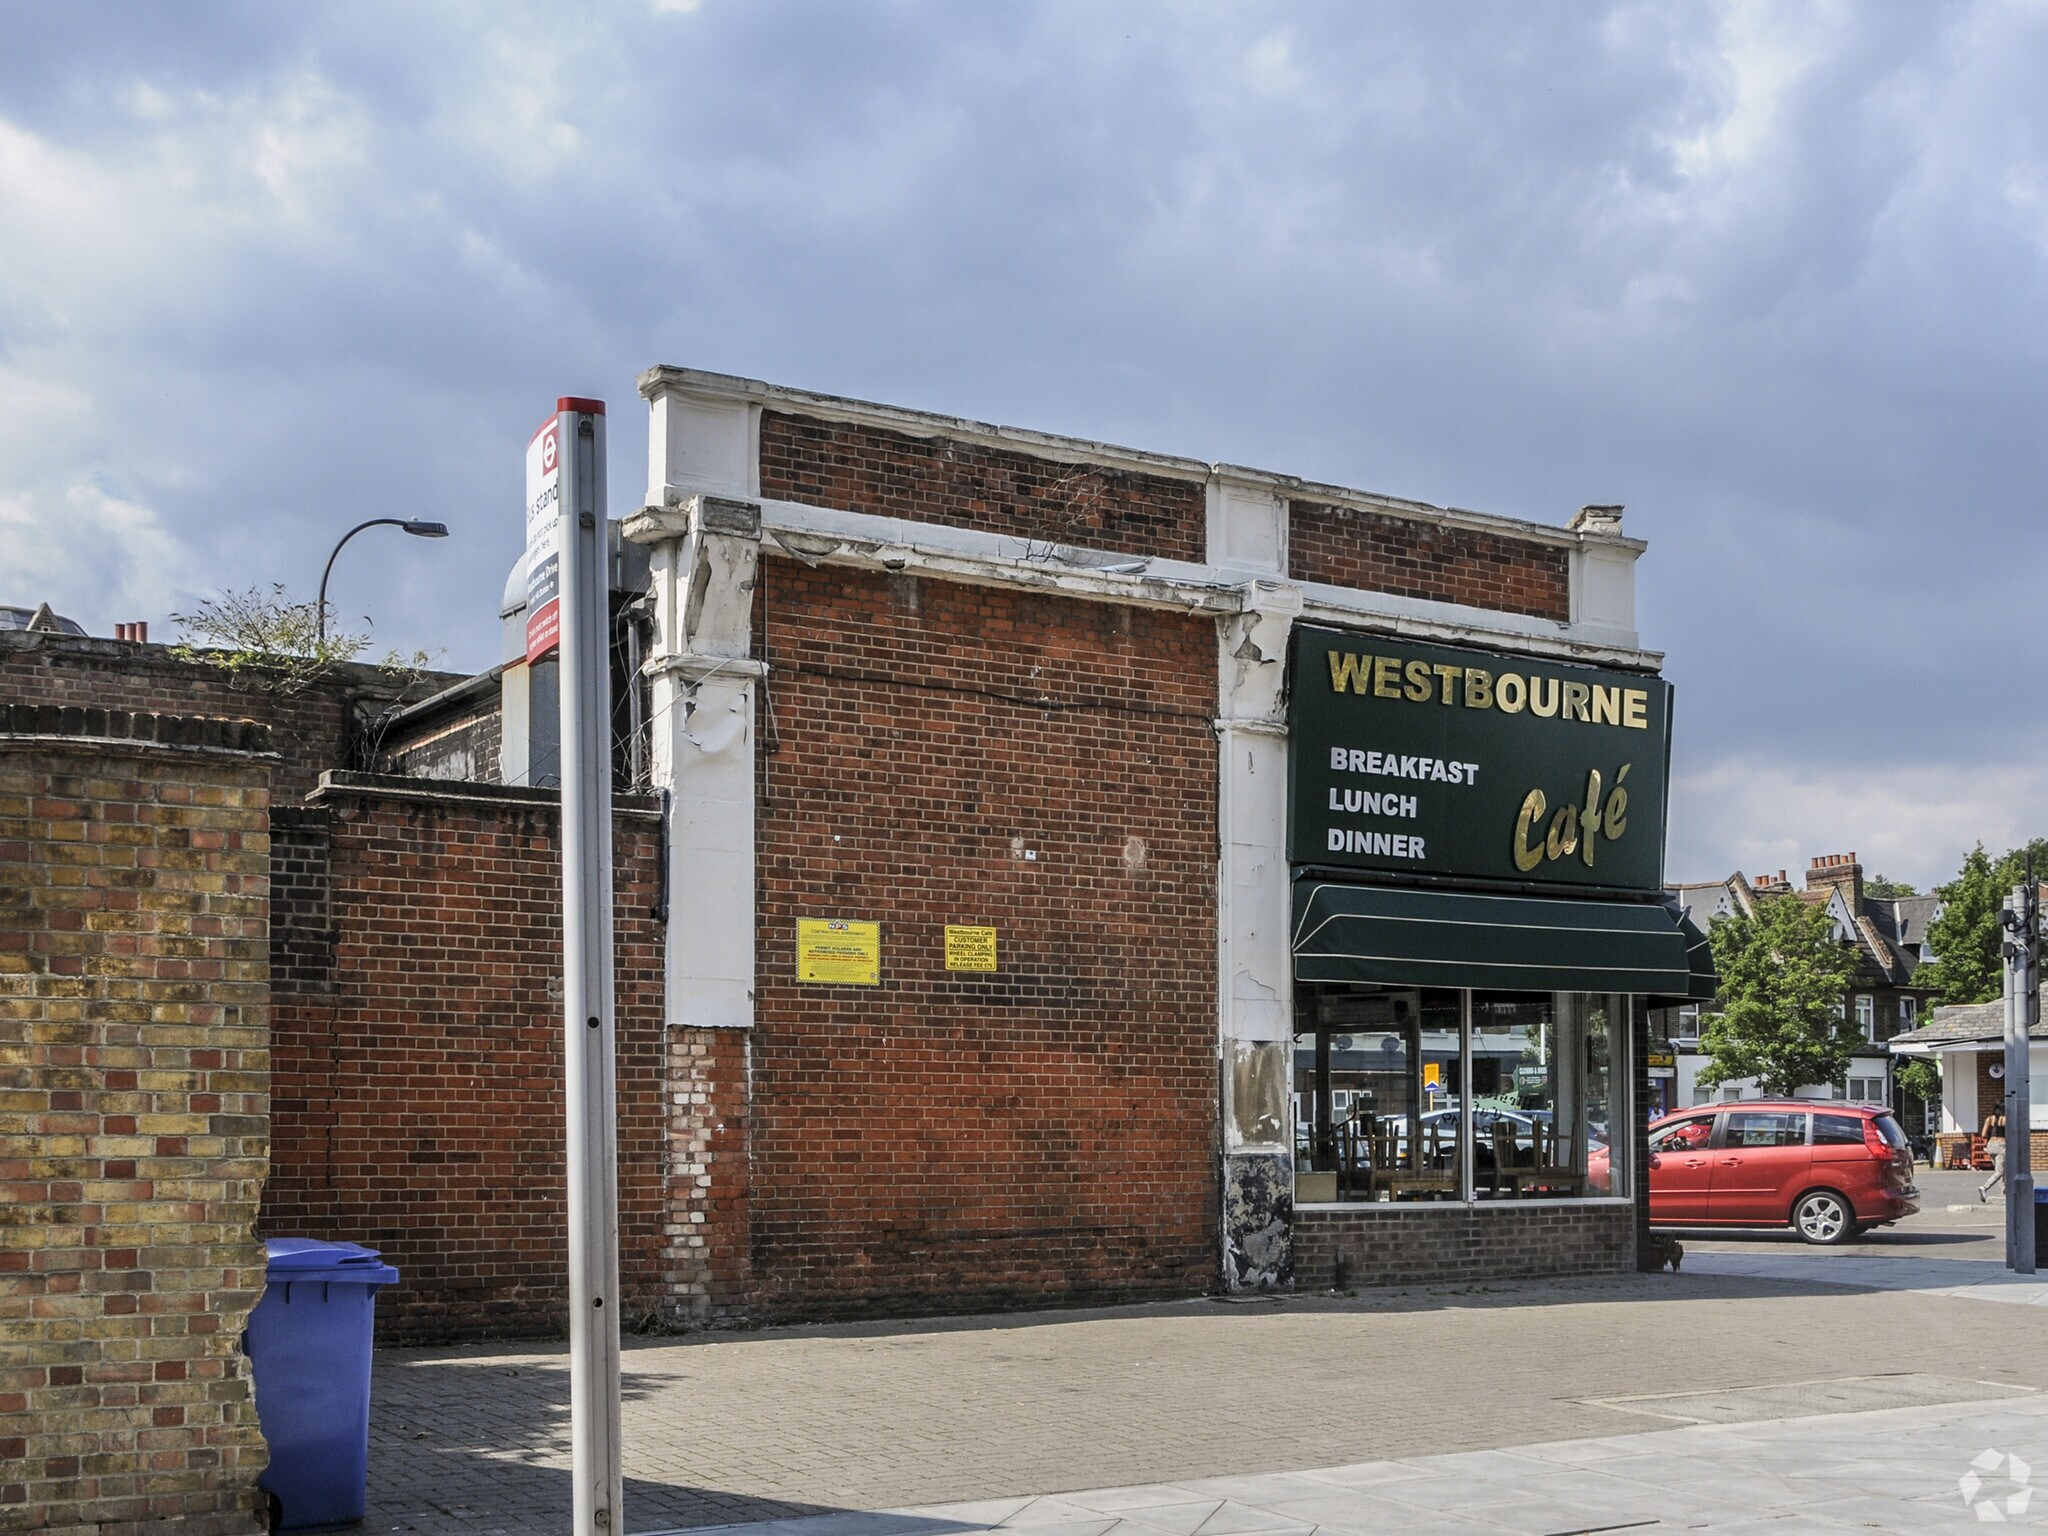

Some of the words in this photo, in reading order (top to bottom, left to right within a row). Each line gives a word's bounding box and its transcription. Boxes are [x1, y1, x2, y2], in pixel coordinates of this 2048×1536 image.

[536, 477, 559, 514] stand
[1328, 650, 1648, 729] WESTBOURNE
[1331, 747, 1479, 786] BREAKFAST
[1329, 788, 1418, 819] LUNCH
[1514, 763, 1632, 872] Café
[1328, 828, 1426, 860] DINNER
